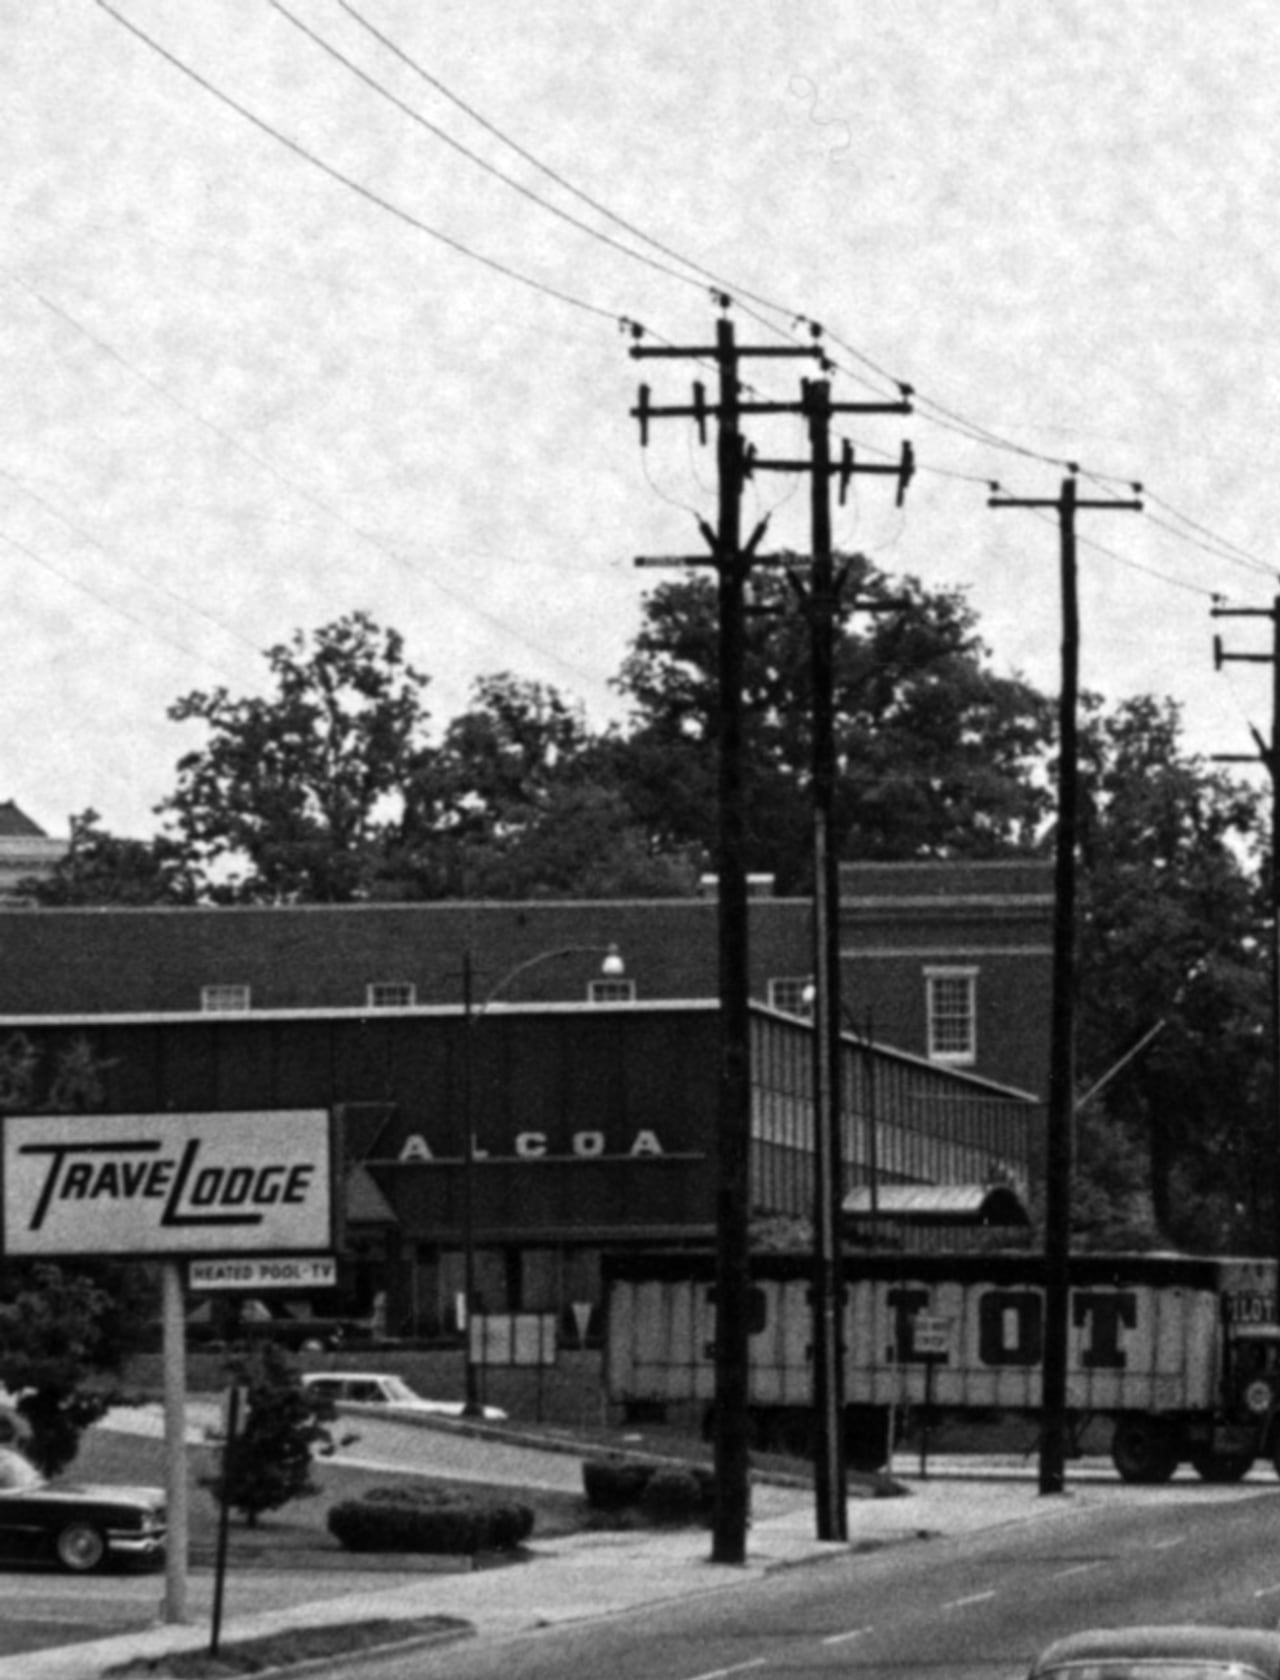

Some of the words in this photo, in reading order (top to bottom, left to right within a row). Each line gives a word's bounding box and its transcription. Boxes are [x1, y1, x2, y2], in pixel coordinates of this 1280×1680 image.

[399, 1129, 663, 1163] ALCOA
[194, 1265, 253, 1281] HEATED
[705, 1287, 1138, 1369] PLOT
